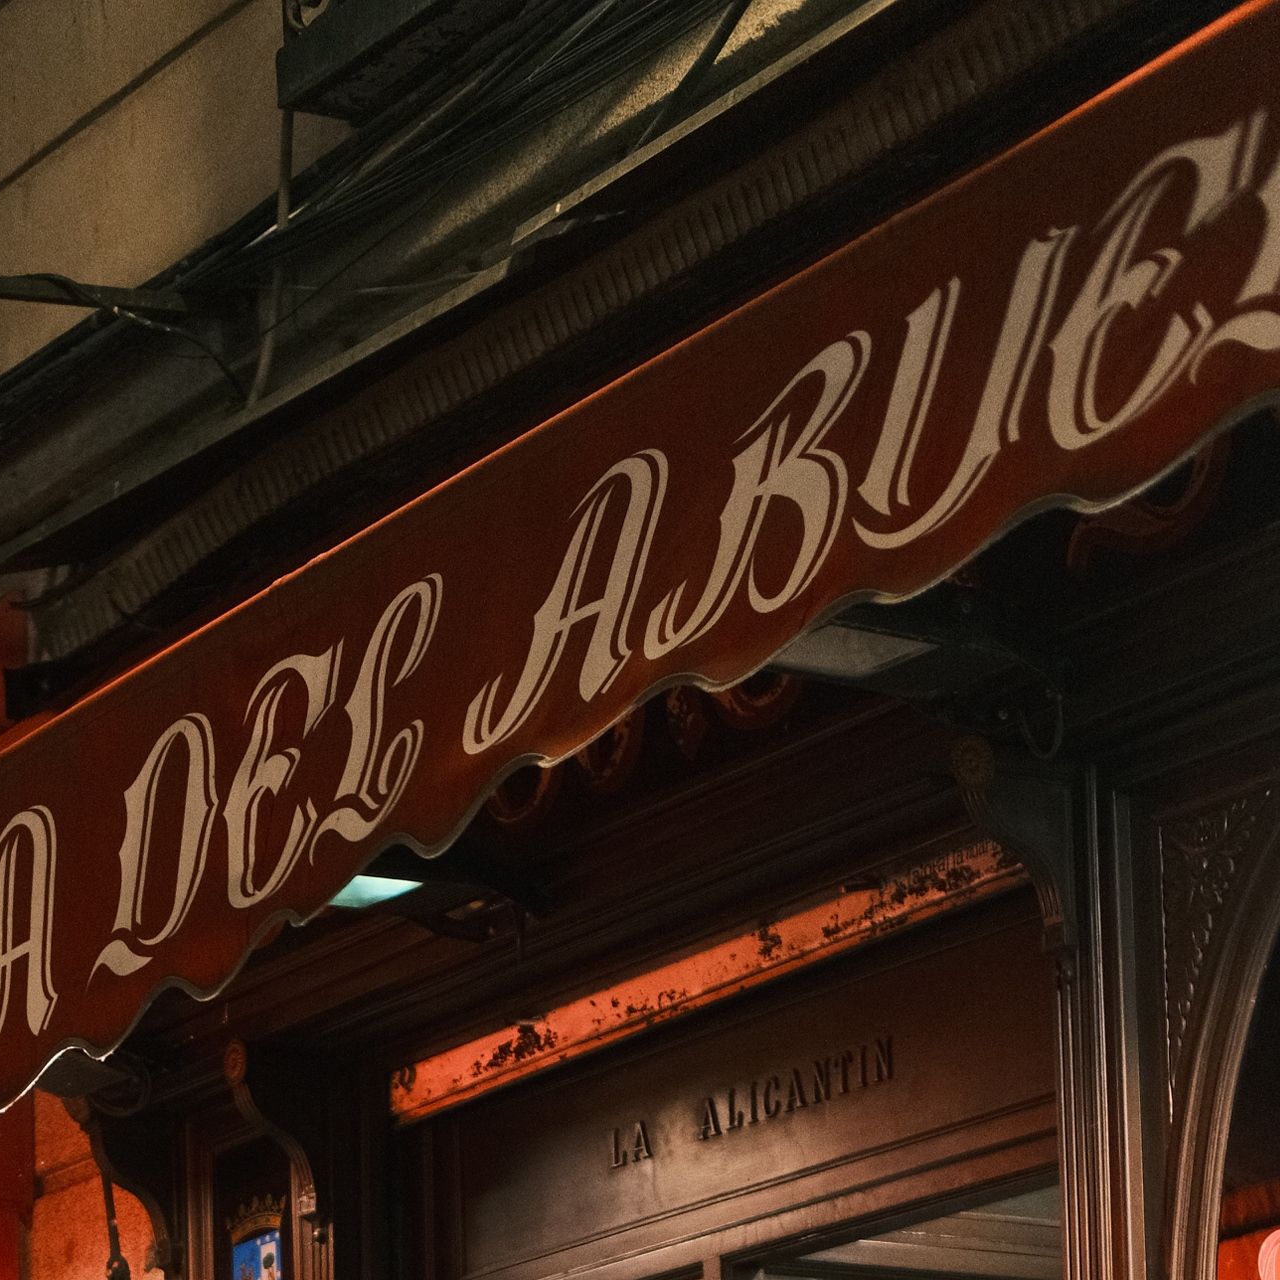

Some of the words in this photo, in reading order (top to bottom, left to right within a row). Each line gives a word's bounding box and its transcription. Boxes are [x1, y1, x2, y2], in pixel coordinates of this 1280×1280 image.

[86, 572, 443, 991] DEL
[609, 1119, 653, 1168] LA
[697, 1035, 896, 1141] ALICANTIN
